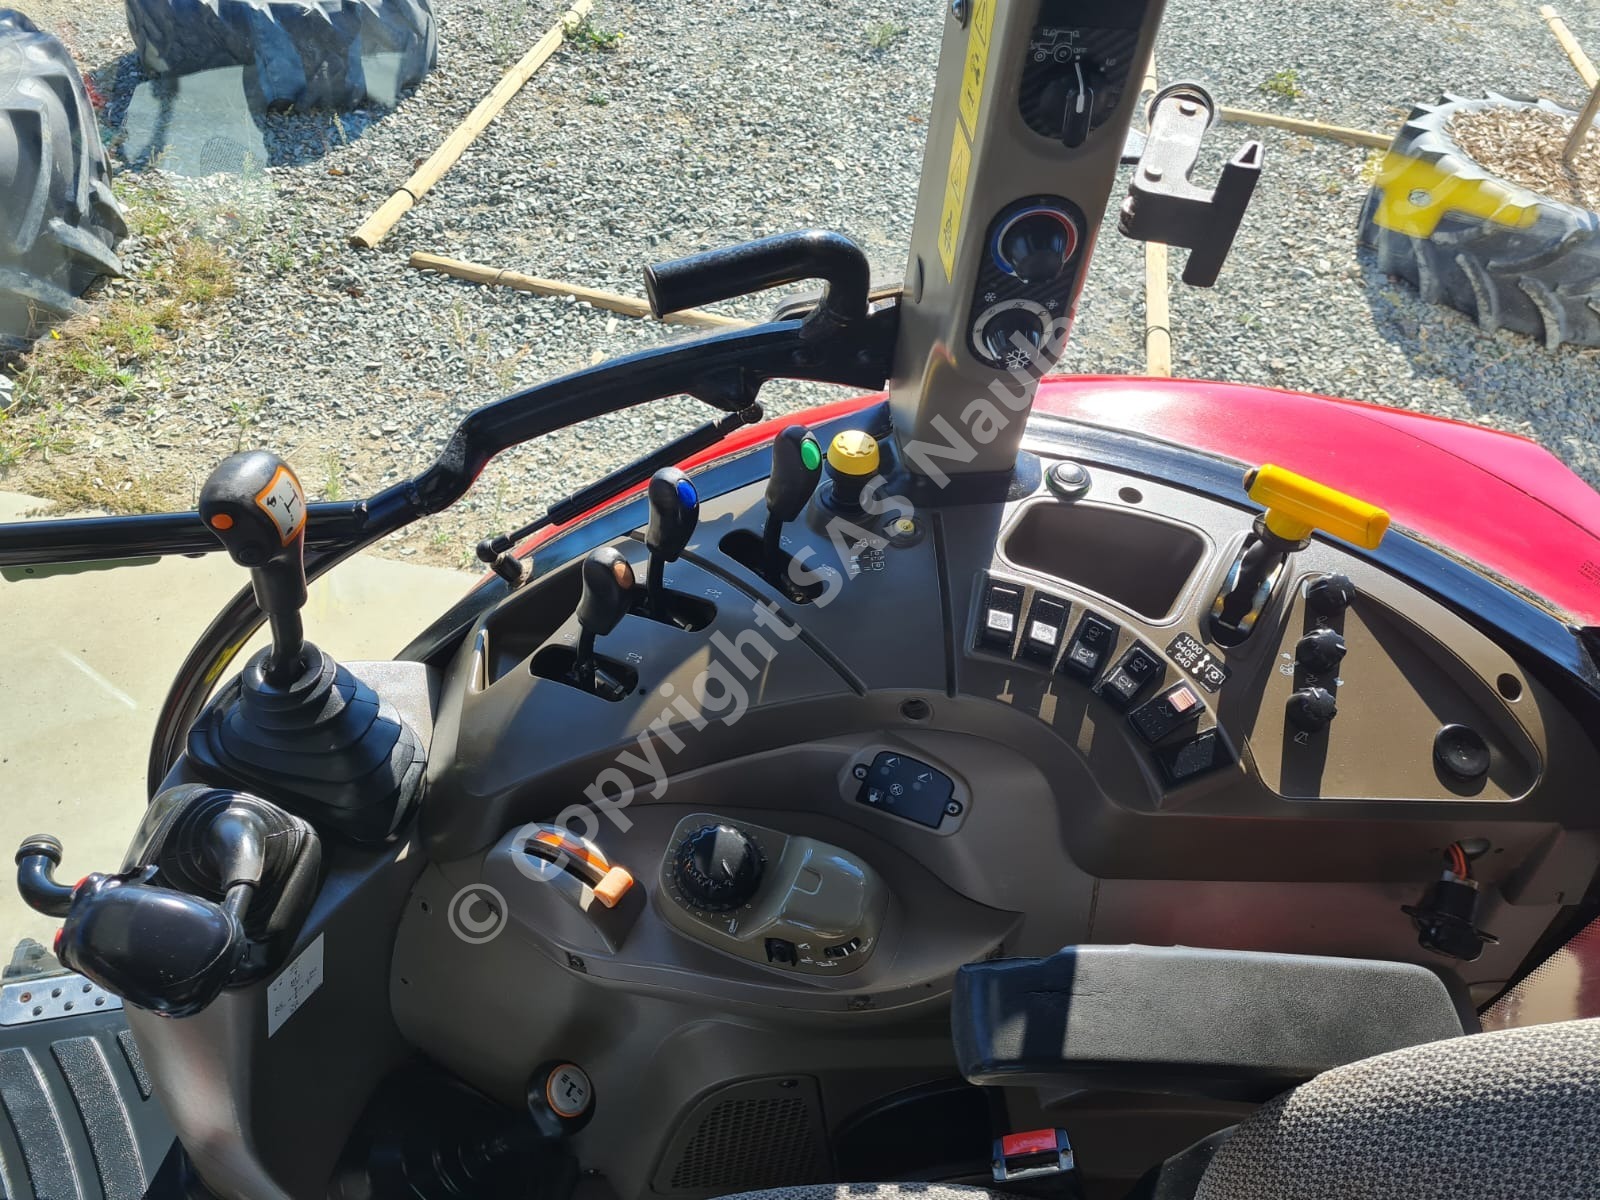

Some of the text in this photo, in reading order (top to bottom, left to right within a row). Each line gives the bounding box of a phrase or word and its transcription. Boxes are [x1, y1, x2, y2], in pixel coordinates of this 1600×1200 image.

[1175, 641, 1198, 662] 540E
[1183, 636, 1203, 655] 1000
[1174, 652, 1191, 668] 540
